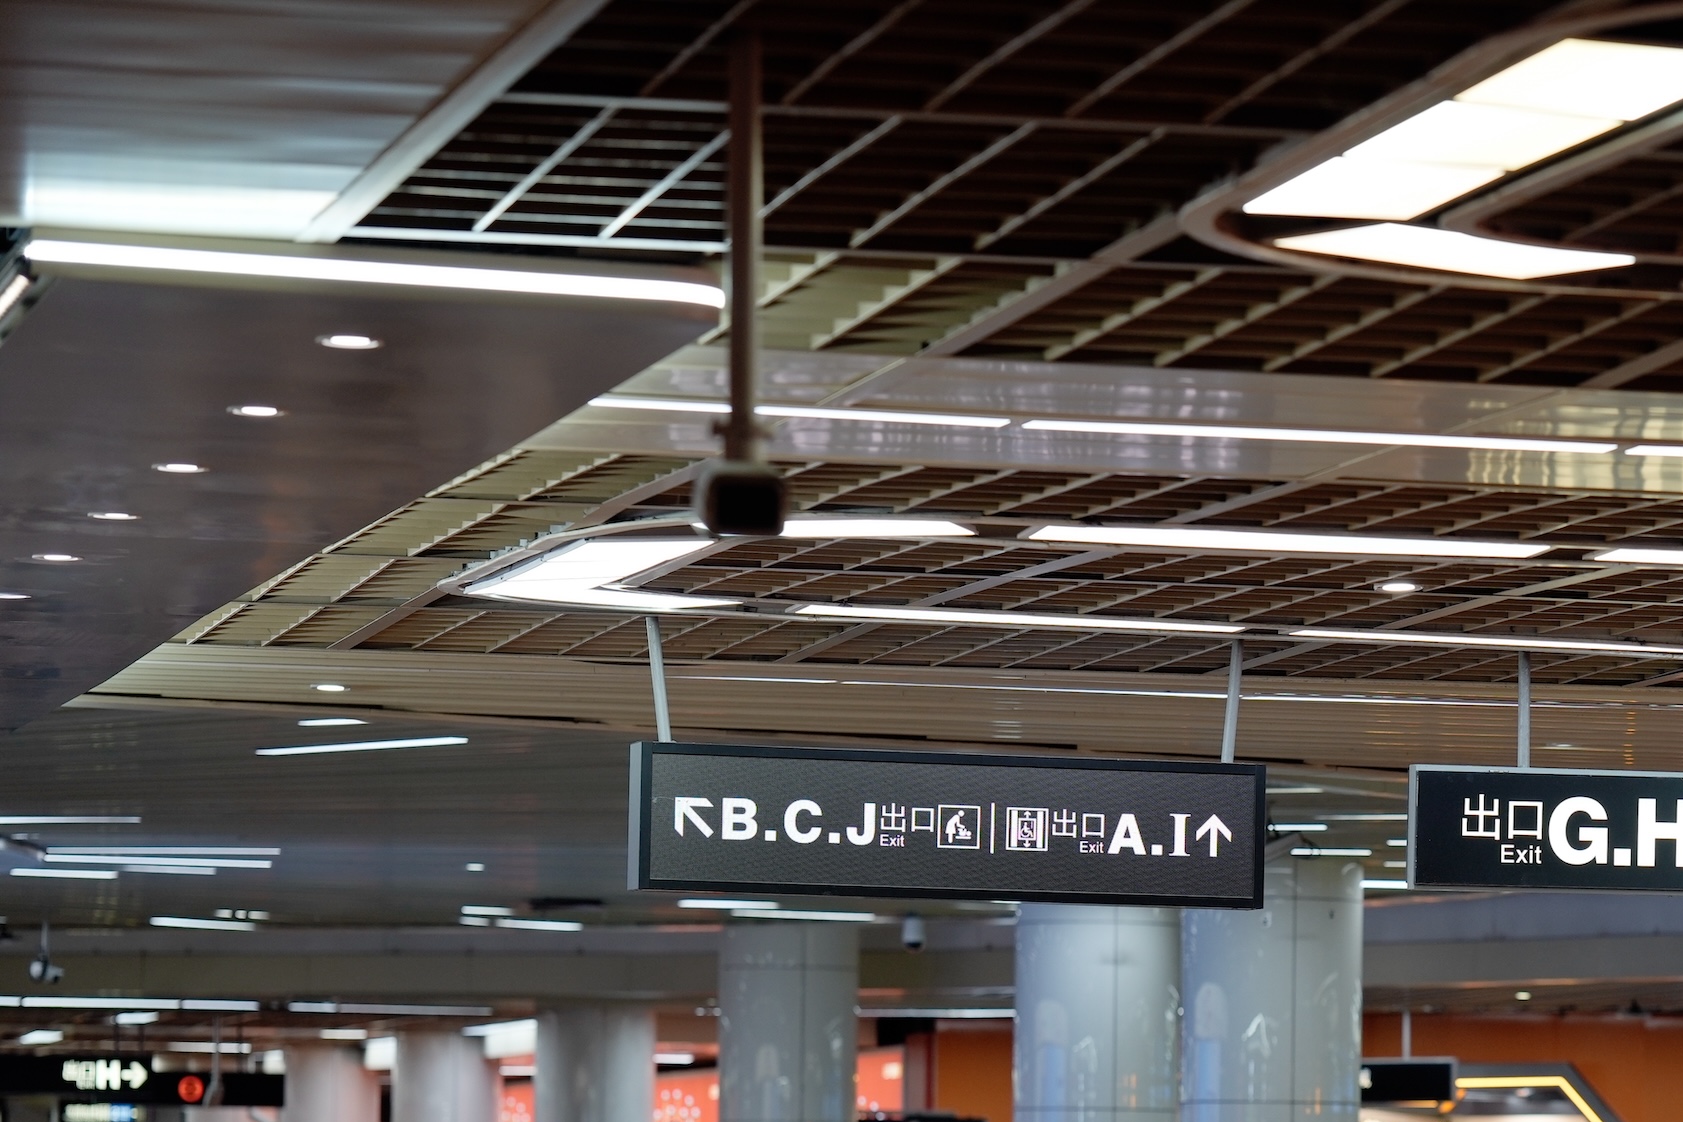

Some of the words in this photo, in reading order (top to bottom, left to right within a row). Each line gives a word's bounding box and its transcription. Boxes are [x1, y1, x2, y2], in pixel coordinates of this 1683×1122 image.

[720, 797, 876, 846] B.C.J
[880, 803, 935, 833] 出口
[1052, 810, 1105, 838] 出口
[1461, 793, 1544, 841] 出口
[879, 834, 905, 848] Exit
[1079, 840, 1105, 854] Exit
[1501, 843, 1543, 865] Exit
[95, 1058, 121, 1090] H
